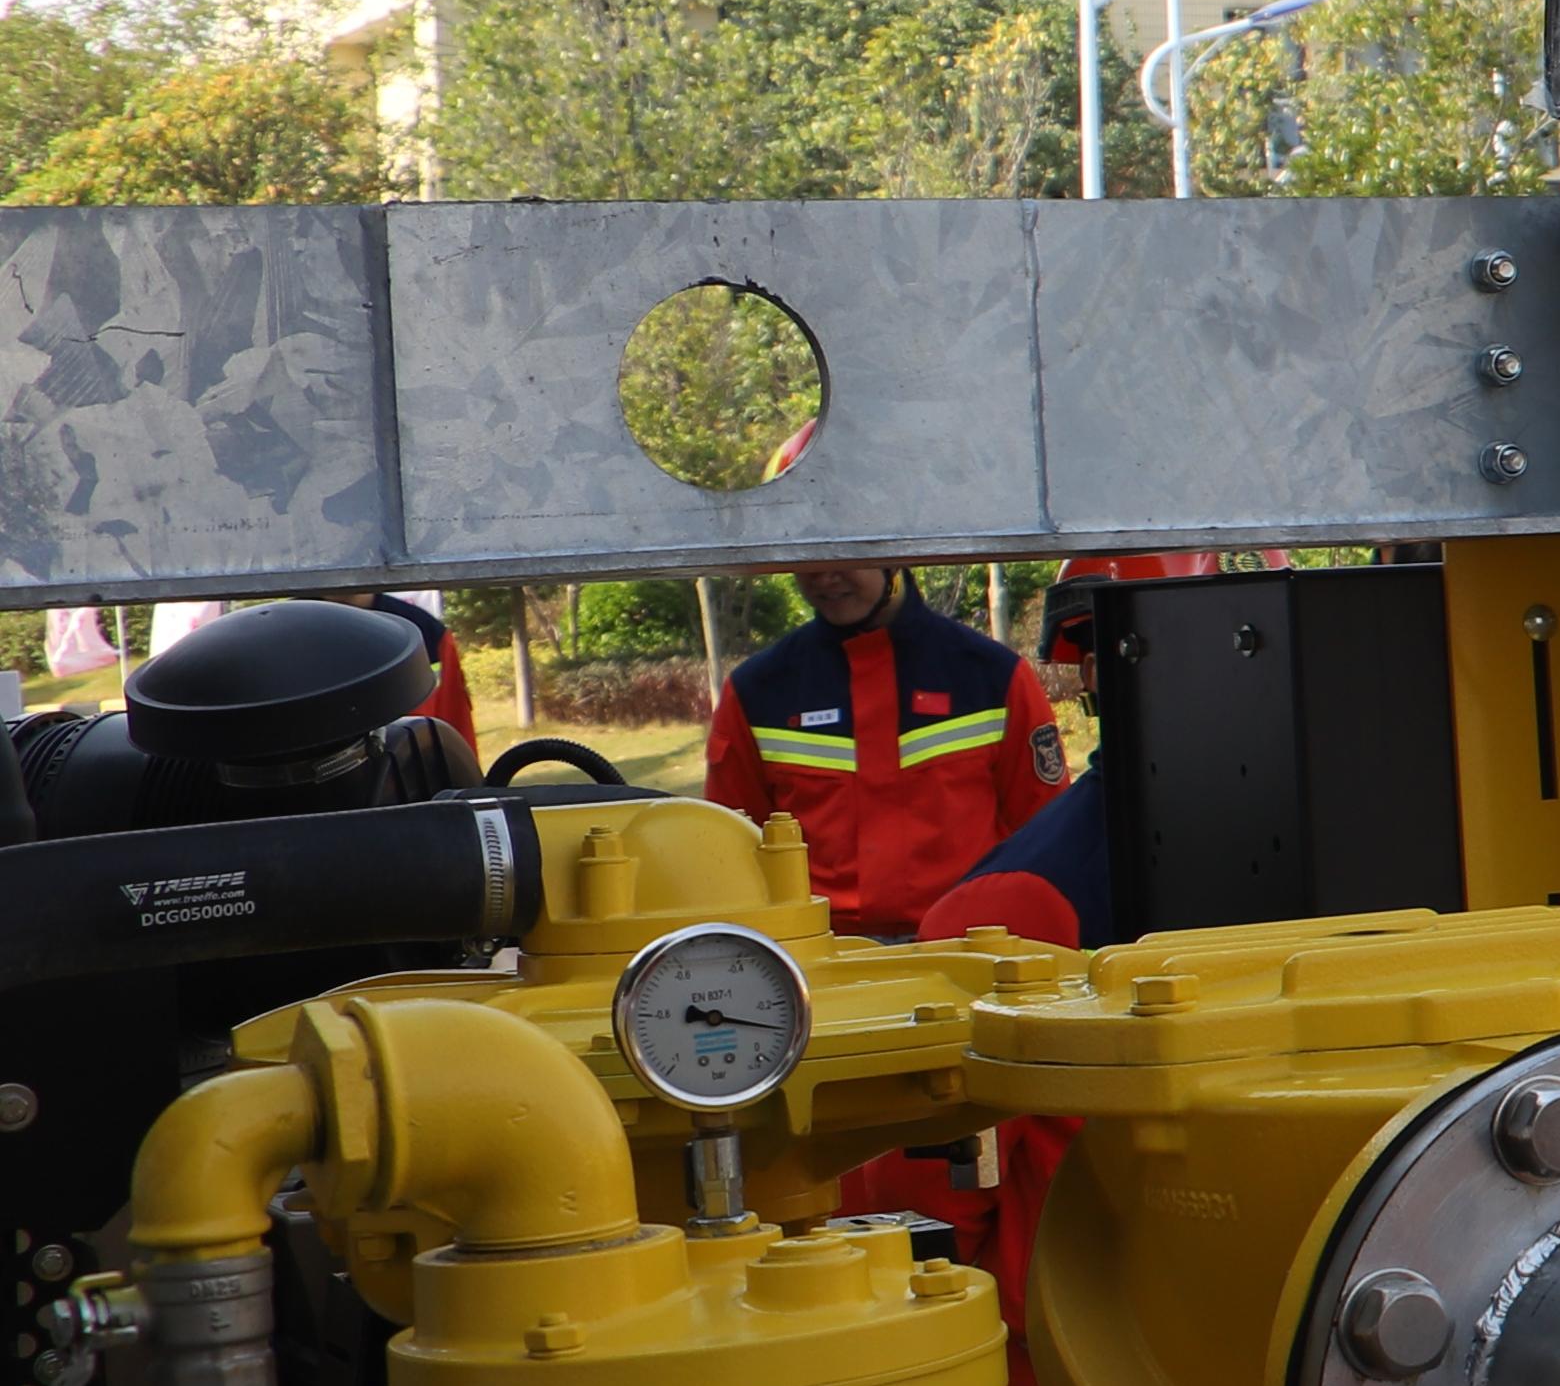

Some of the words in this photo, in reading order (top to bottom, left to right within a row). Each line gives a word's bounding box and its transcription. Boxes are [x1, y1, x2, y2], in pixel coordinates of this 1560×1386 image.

[153, 871, 246, 895] TREEFFE
[141, 900, 256, 927] DCG0500000
[712, 1070, 727, 1080] bar
